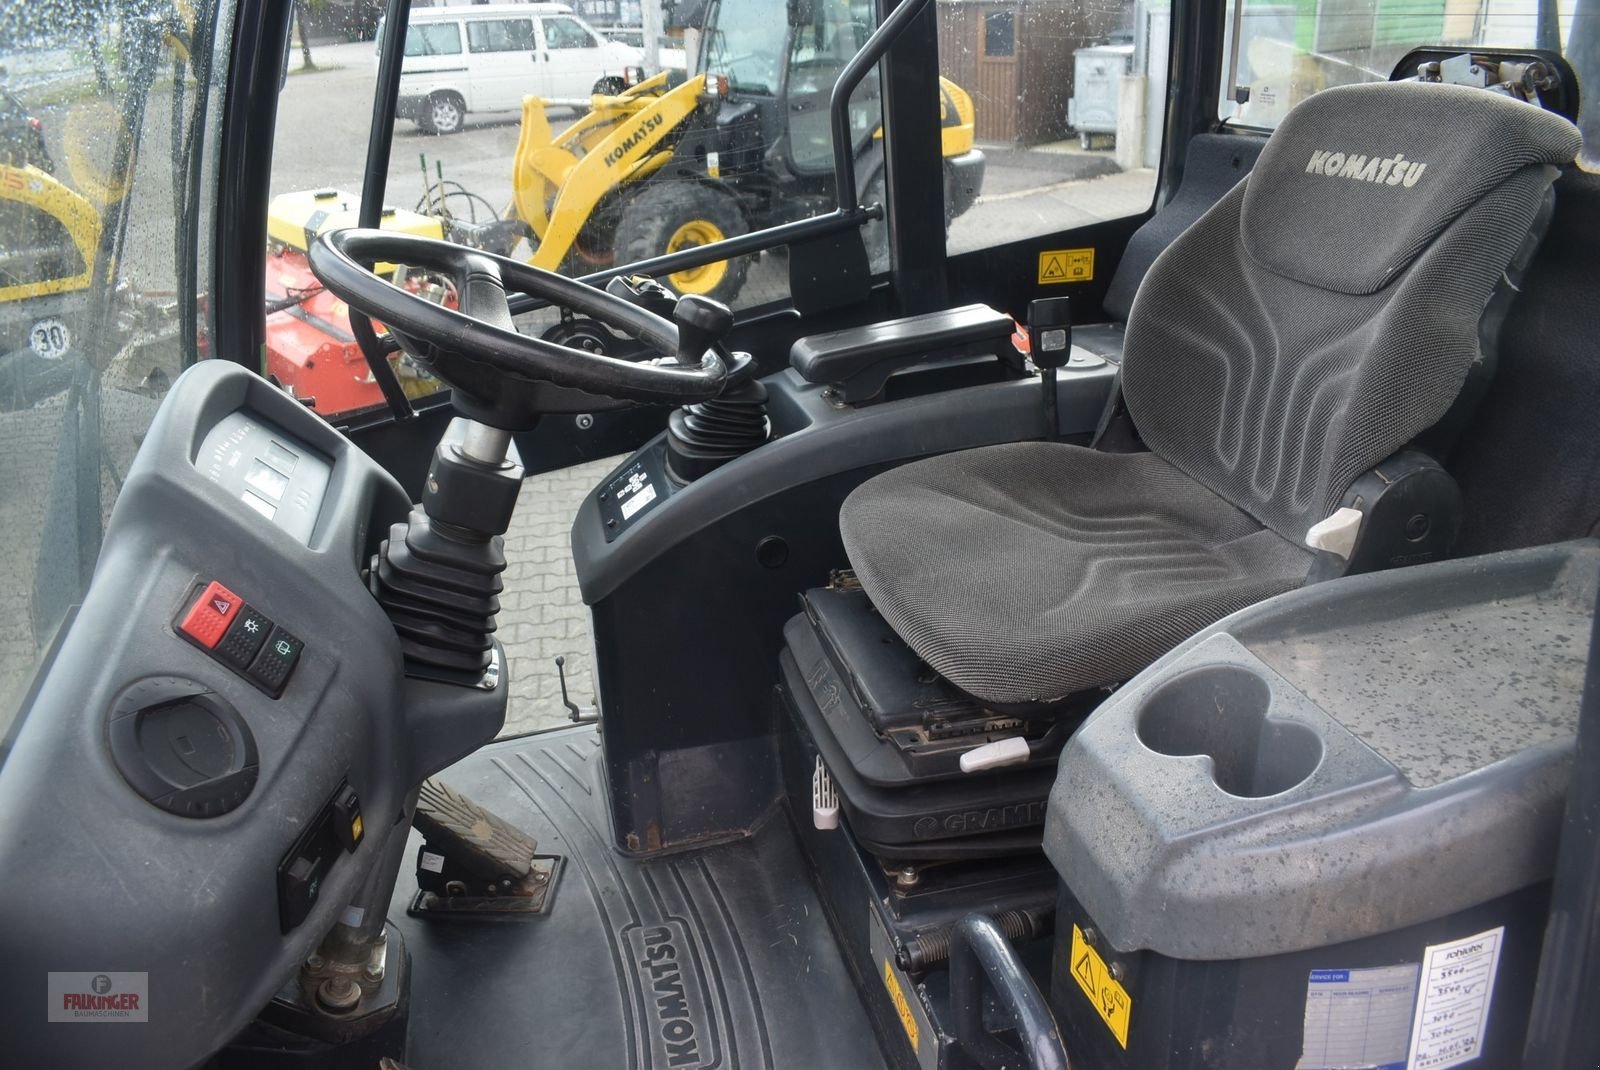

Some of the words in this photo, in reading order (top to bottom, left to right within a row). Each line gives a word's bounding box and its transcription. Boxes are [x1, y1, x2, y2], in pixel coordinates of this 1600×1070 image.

[604, 113, 663, 168] KOMATSU
[1305, 149, 1427, 188] KOMATSU
[36, 326, 64, 352] 30
[640, 926, 701, 1068] KOMATSU
